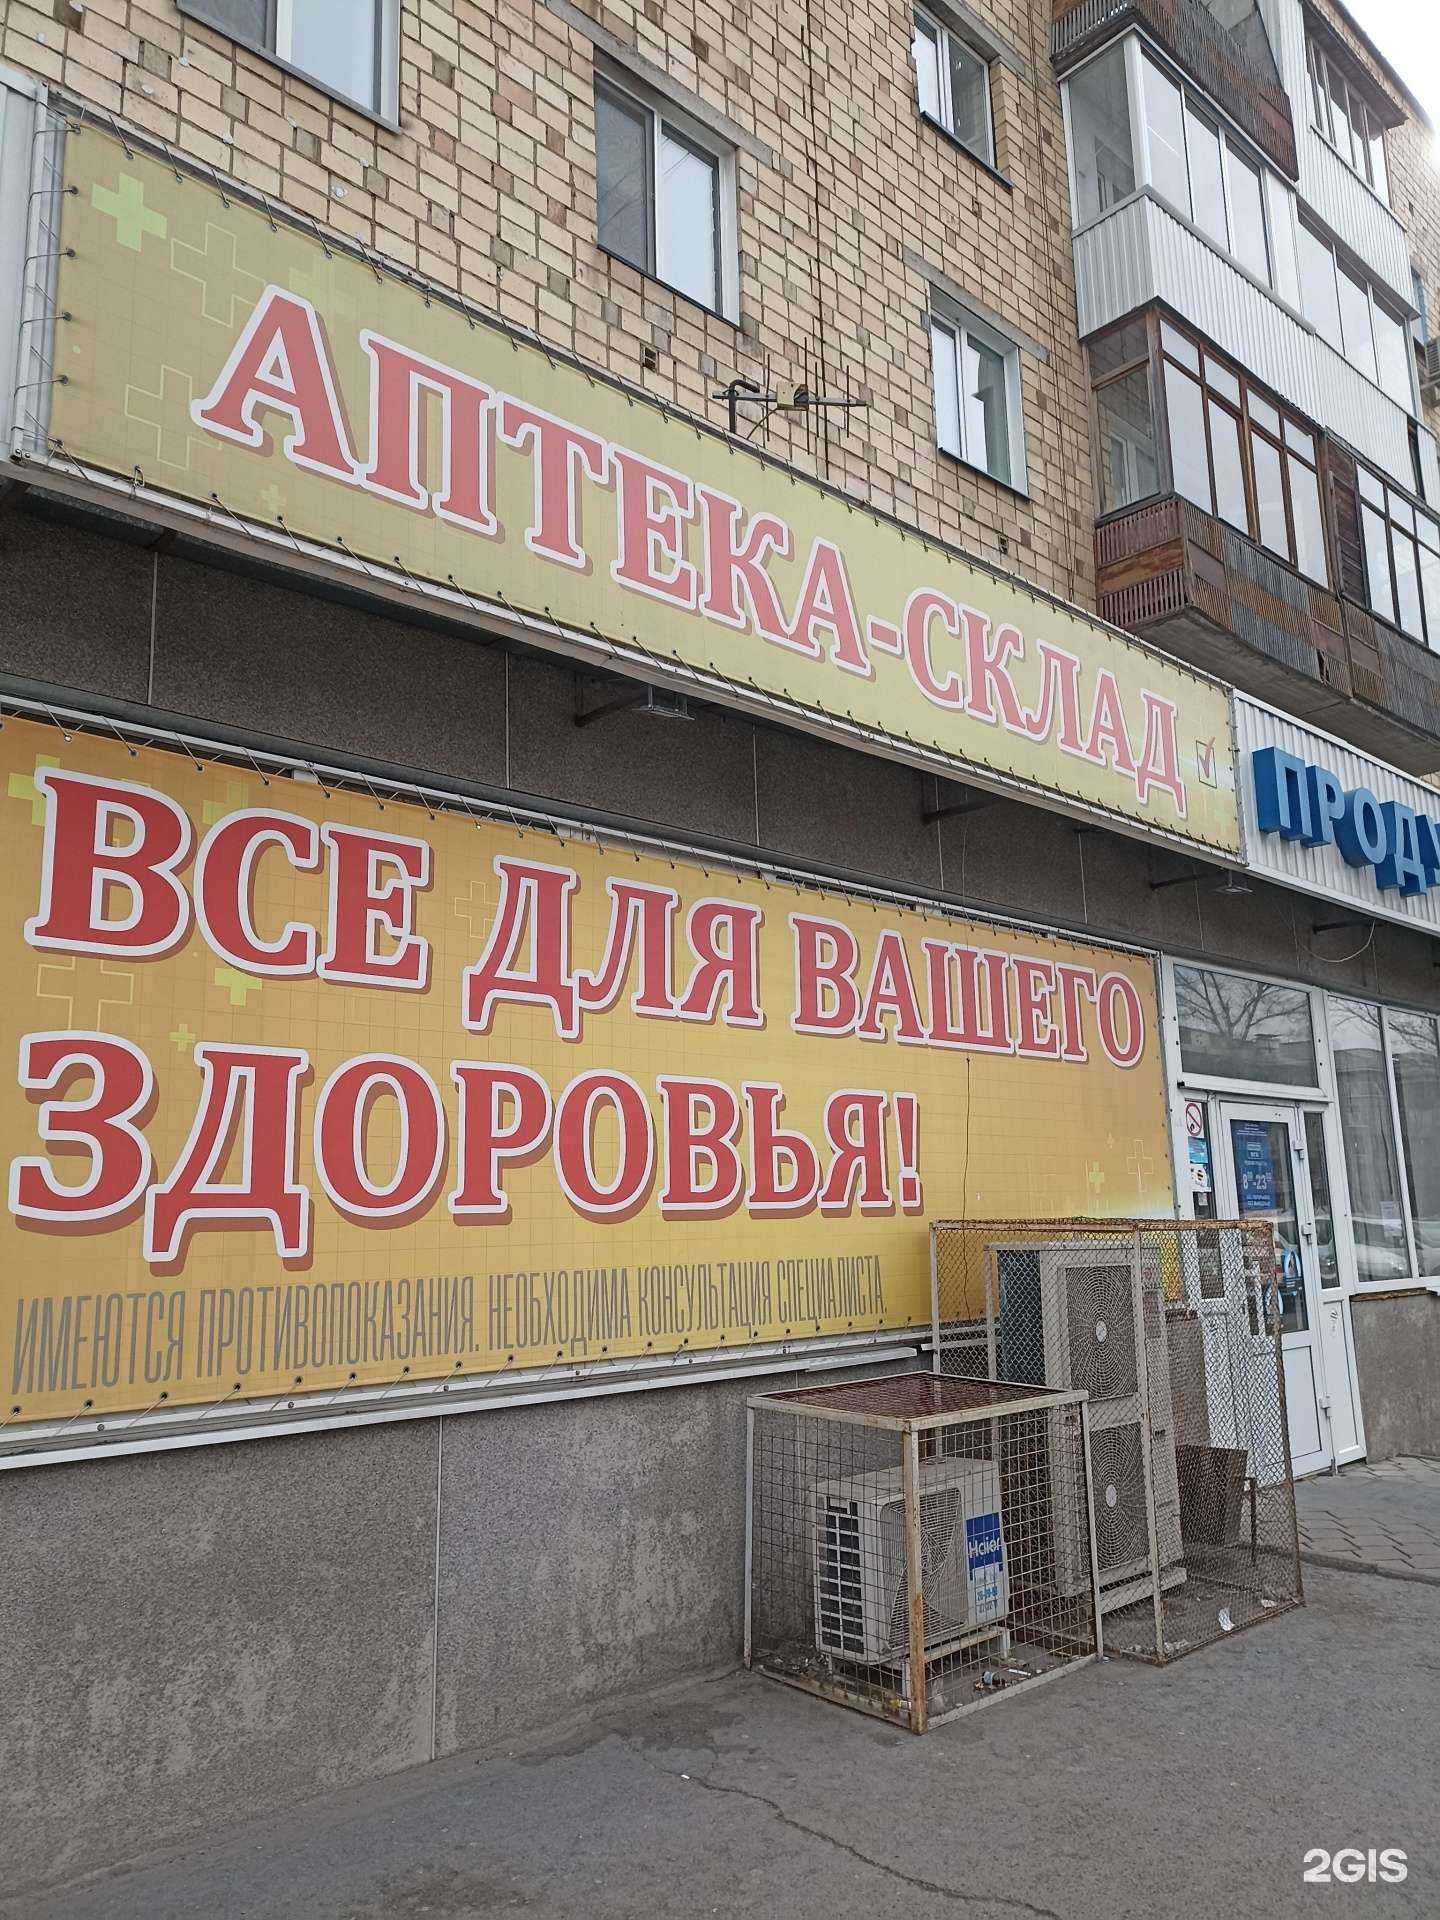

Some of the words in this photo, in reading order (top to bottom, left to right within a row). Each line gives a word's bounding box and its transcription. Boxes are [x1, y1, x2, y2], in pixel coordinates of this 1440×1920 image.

[190, 284, 1187, 820] АПТЕКА-СКЛАД
[24, 767, 430, 989] ВСЕ
[462, 854, 764, 1040] ДЛЯ
[788, 912, 1145, 1067] ВАШЕГО
[8, 1031, 922, 1262] ЗДОРОВЬЯ!
[11, 1290, 186, 1395] ИМЕЮТСЯ
[199, 1276, 480, 1377] ПРОТИВОПОКАЗАНИЯ.
[488, 1267, 630, 1356] НЕОБХОДИМА
[637, 1261, 771, 1338] КОНСУЛЬТАЦИЯ
[777, 1254, 888, 1325] СПЕЦИАЛИСТА.
[968, 1536, 1000, 1559] Haier
